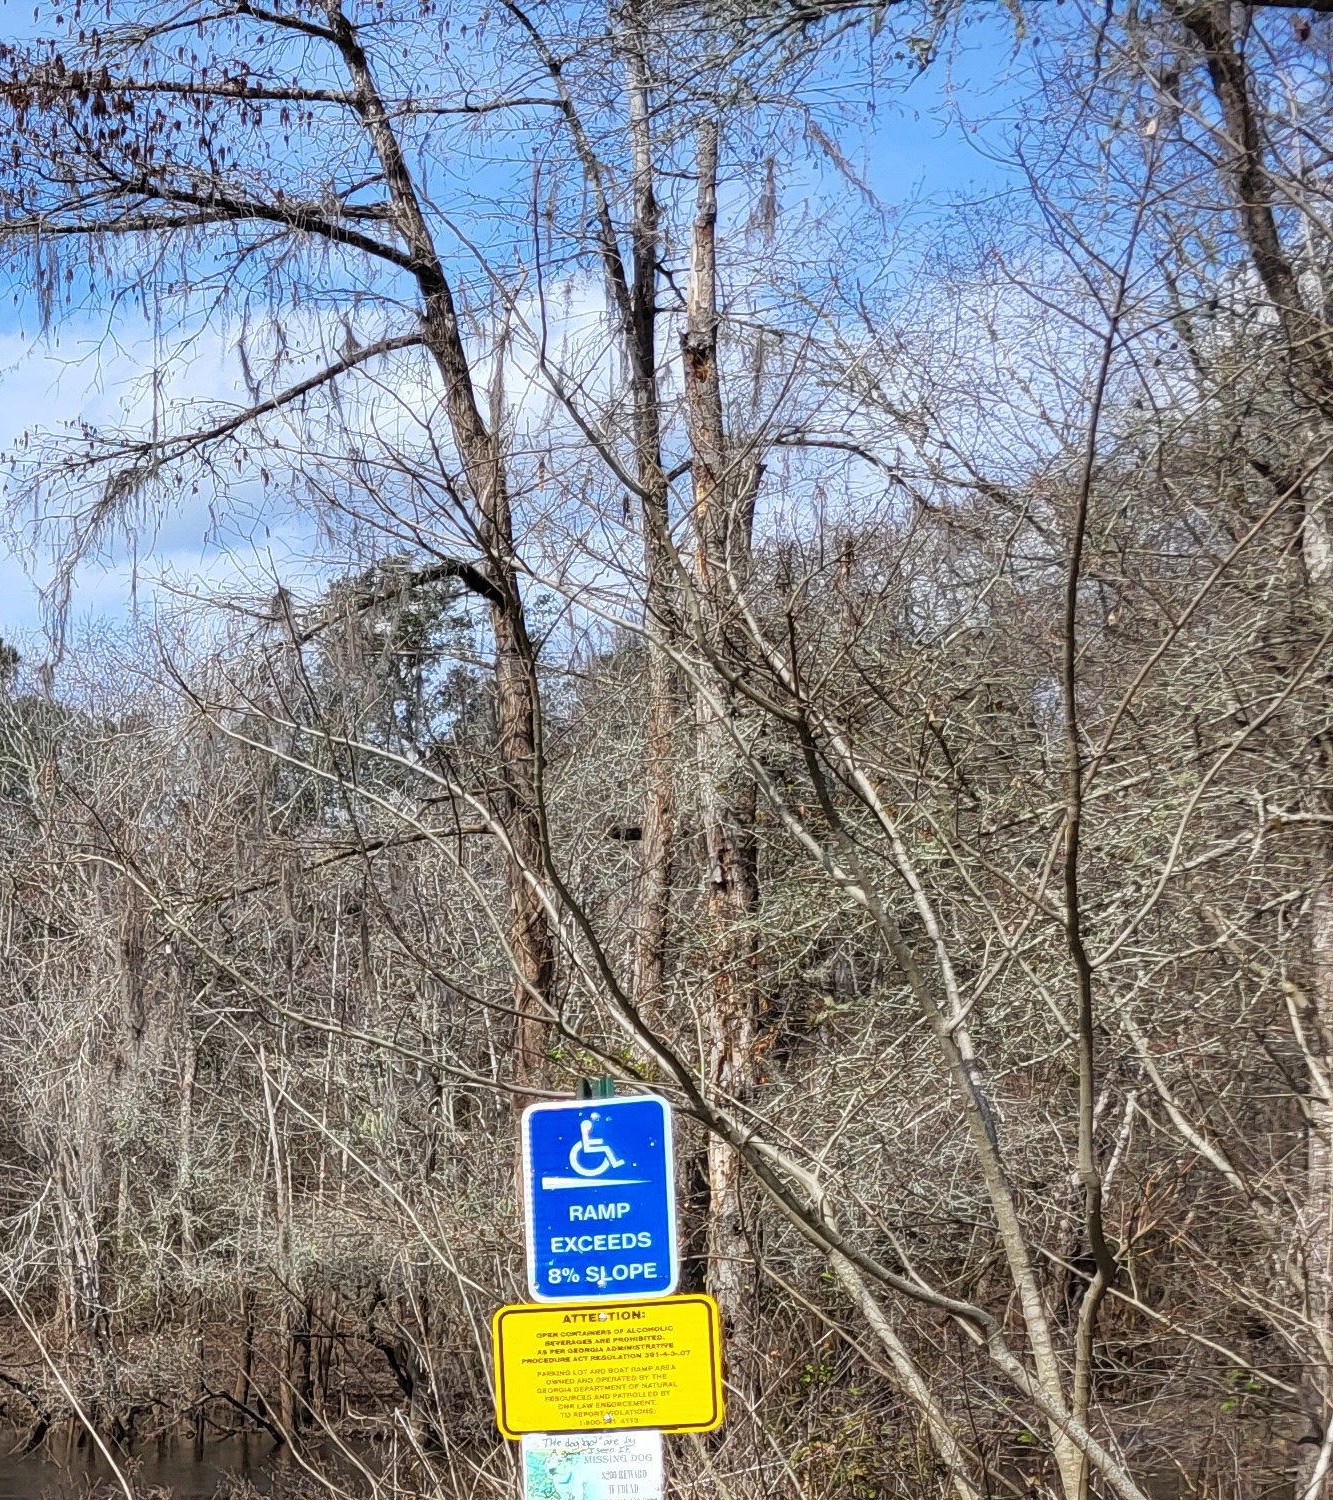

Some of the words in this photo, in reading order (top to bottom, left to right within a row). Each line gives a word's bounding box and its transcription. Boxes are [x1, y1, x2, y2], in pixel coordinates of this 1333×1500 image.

[569, 1202, 630, 1221] RAMP
[551, 1232, 652, 1253] EXCEEDS
[548, 1267, 580, 1284] 8%
[585, 1262, 657, 1282] SLOPE
[626, 1325, 674, 1334] ALCOHOLIC
[545, 1338, 592, 1346] BEVERAGES
[606, 1342, 674, 1352] ADMINISTRATIVE
[521, 1356, 571, 1364] PROCEDURE
[590, 1352, 641, 1361] REGULATION
[536, 1369, 571, 1377] PARKING
[595, 1374, 637, 1382] OPERATED
[574, 1384, 626, 1392] DEPARTMENT
[641, 1381, 677, 1389] NATURAL
[612, 1390, 659, 1399] PATROLLED
[573, 1410, 604, 1418] REPORT
[584, 1454, 628, 1464] MISSING
[631, 1453, 653, 1462] DOG
